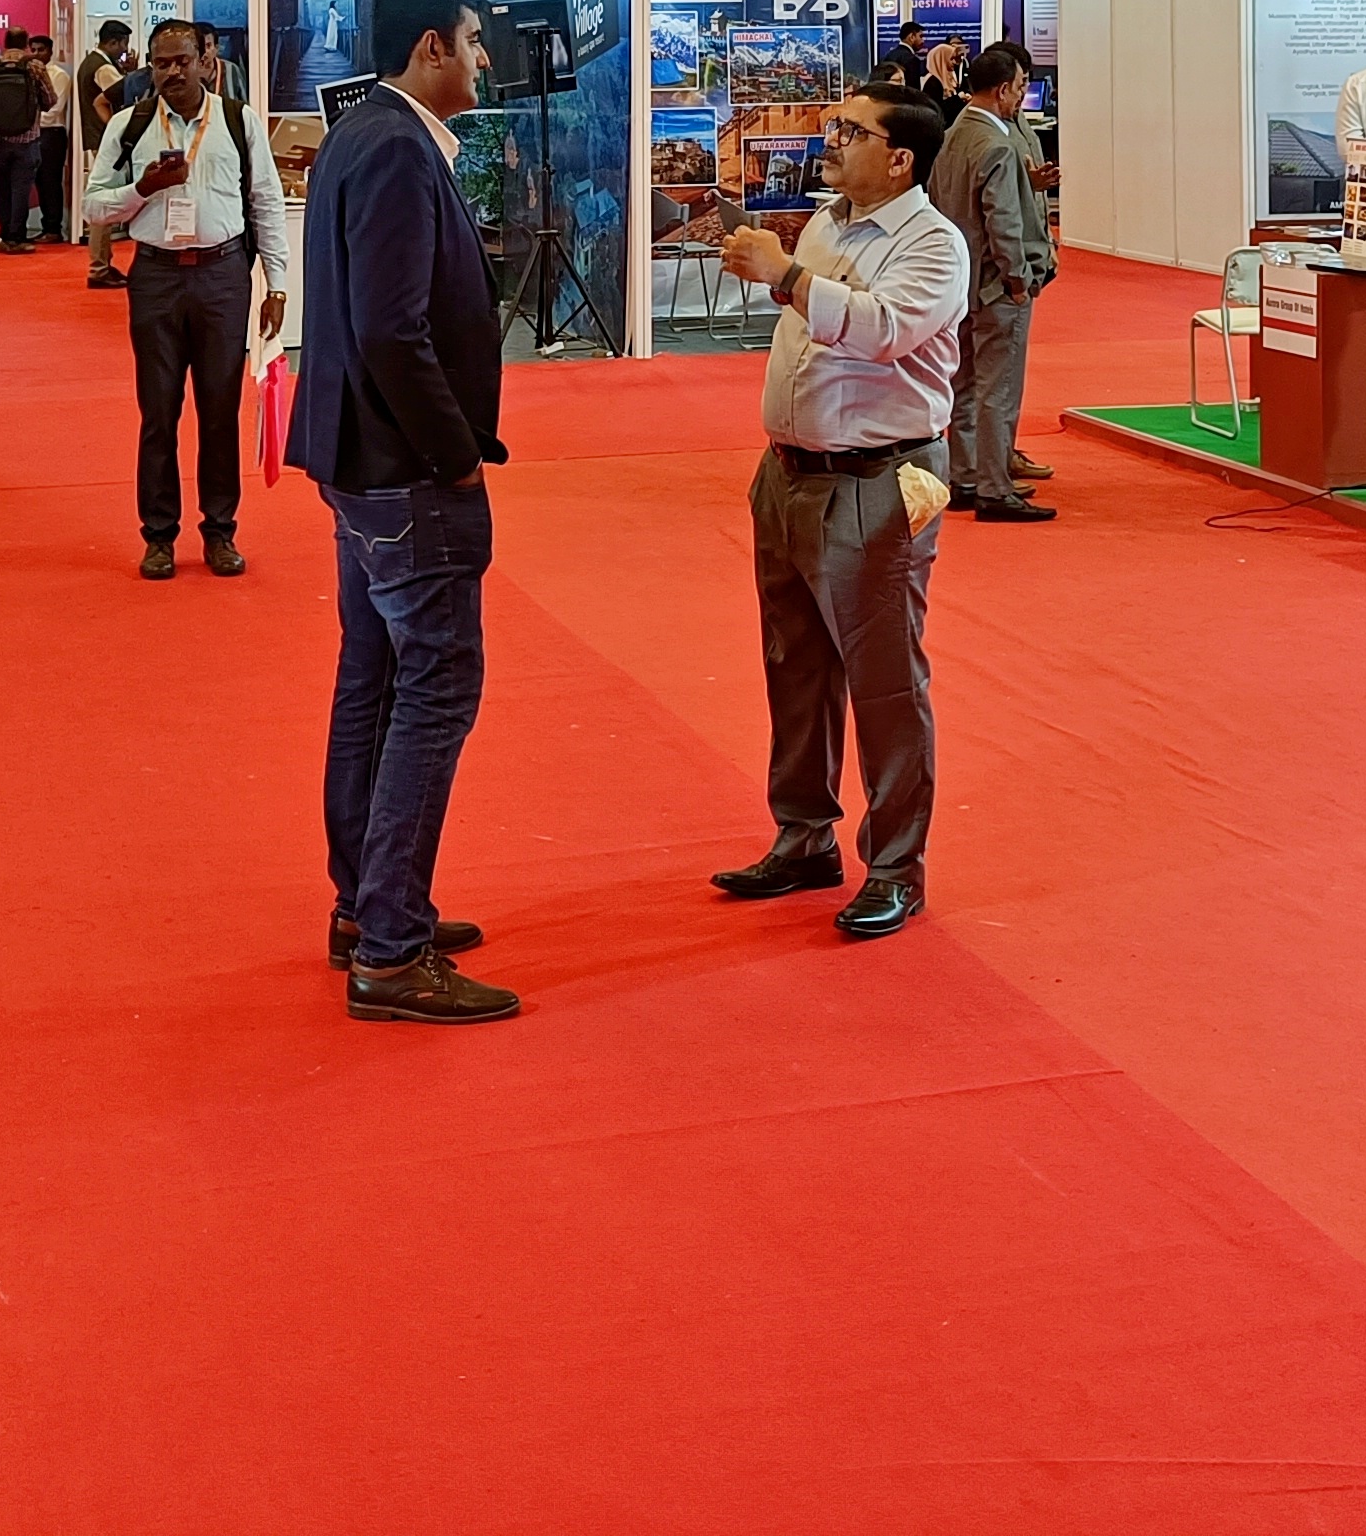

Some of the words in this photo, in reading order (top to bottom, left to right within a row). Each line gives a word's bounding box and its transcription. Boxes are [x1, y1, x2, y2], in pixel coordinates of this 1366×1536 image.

[574, 1, 604, 39] Village
[733, 32, 775, 43] HIMACHAL
[750, 141, 807, 151] UTTARAKHAND
